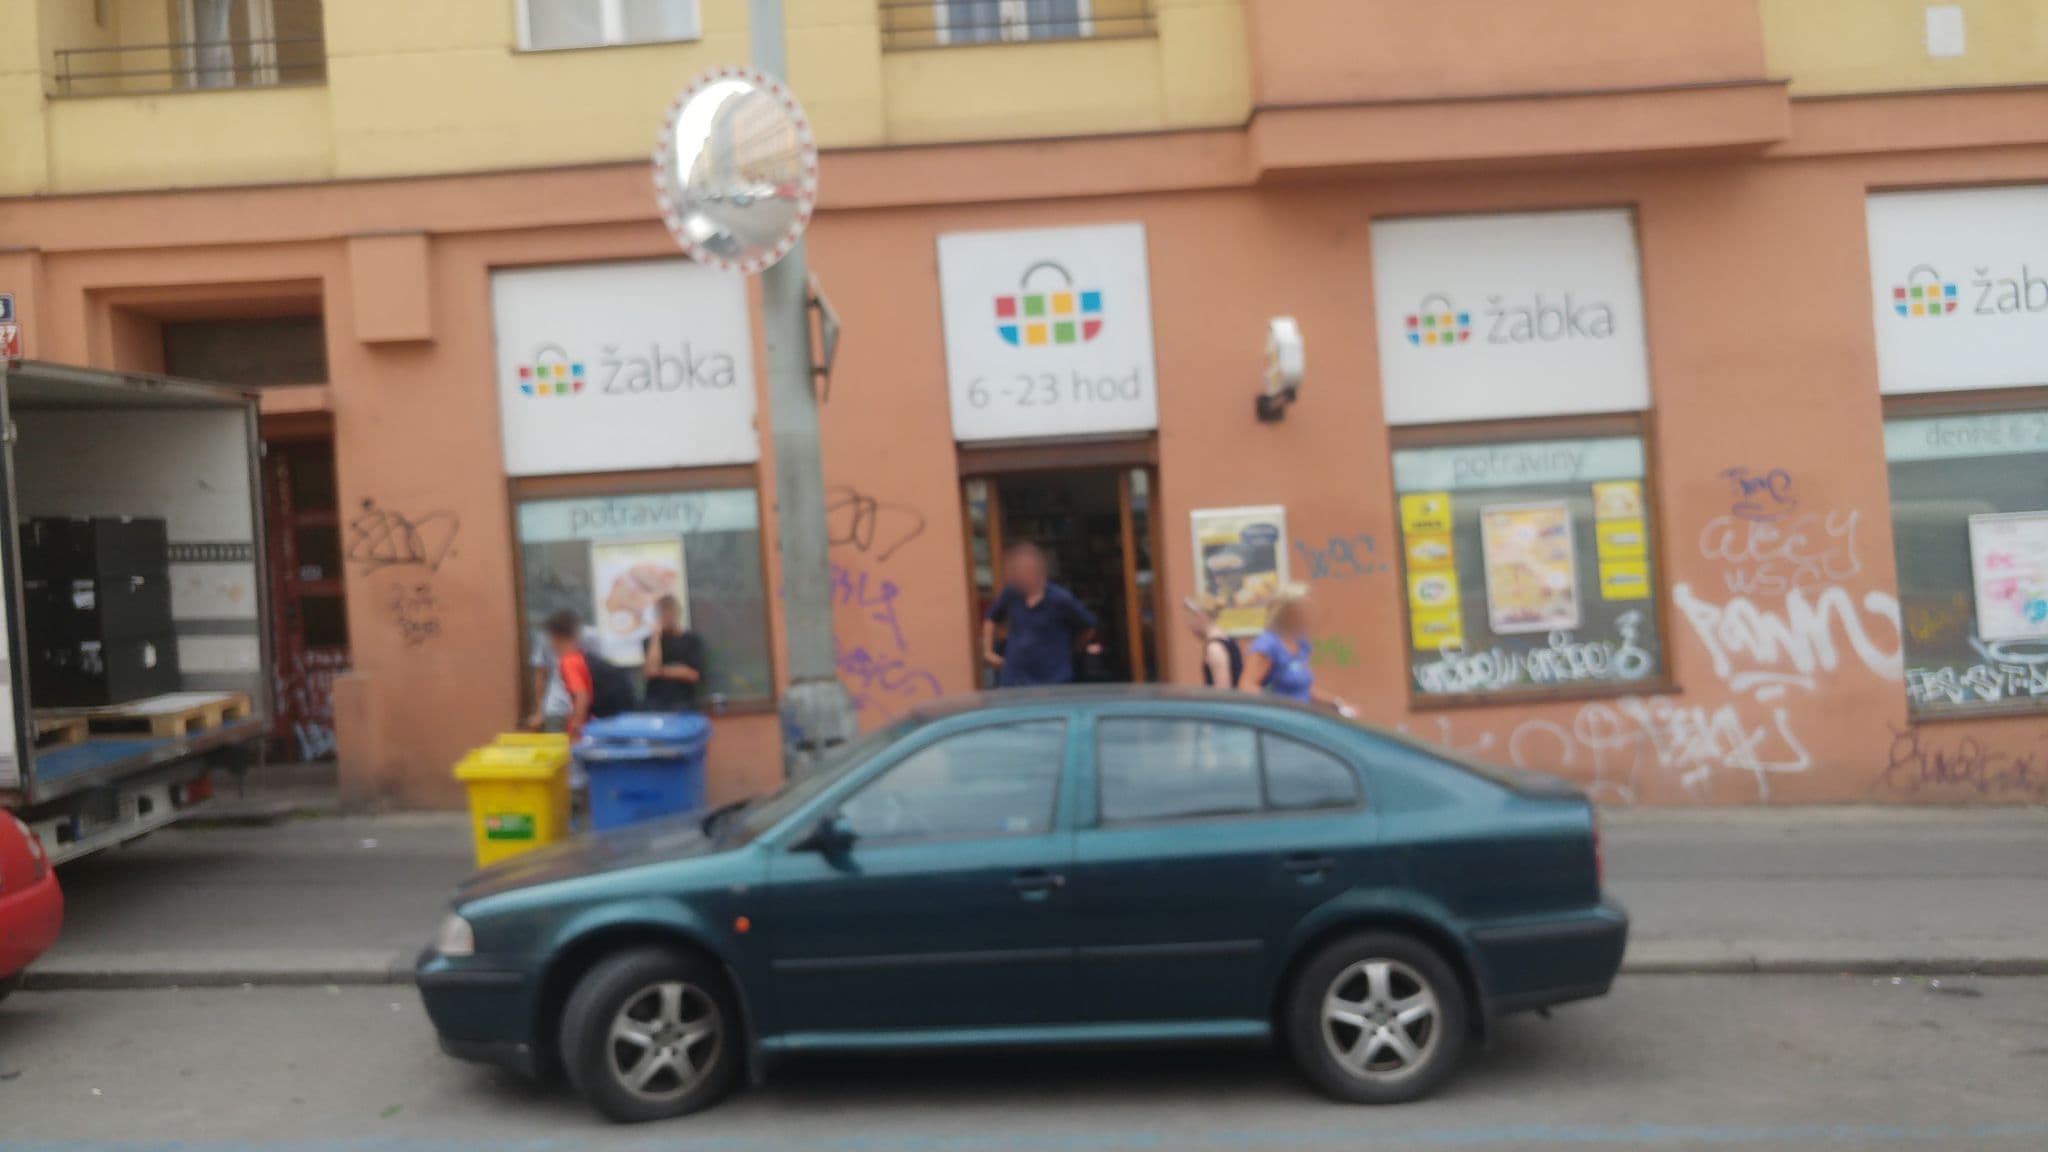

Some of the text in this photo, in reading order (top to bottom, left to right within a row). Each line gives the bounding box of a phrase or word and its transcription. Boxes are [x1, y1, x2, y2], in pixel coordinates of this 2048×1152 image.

[1485, 292, 1615, 344] žabka
[601, 342, 737, 395] žabka
[1072, 367, 1139, 402] hod
[1453, 451, 1586, 484] potraviny
[570, 500, 706, 534] potraviny
